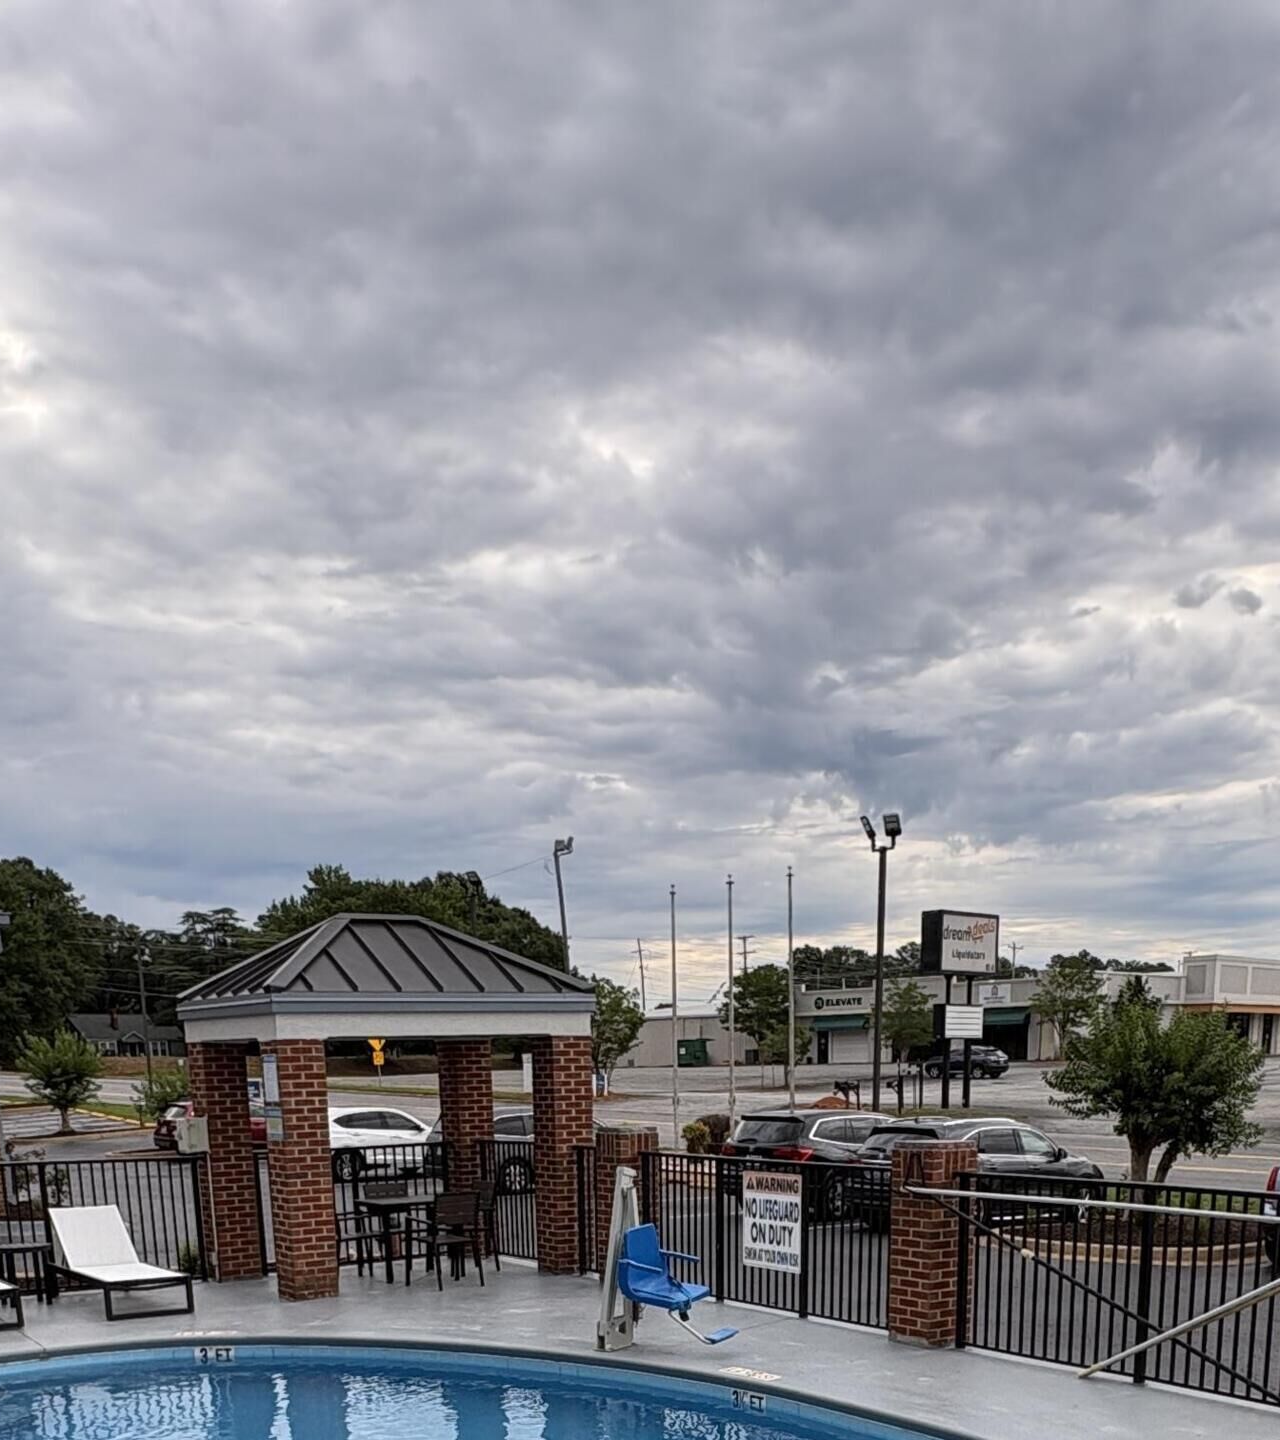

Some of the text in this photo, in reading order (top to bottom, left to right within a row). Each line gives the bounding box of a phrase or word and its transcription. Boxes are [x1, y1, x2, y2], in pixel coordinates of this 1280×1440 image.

[825, 997, 863, 1007] ELEVATE
[755, 1176, 799, 1194] WARNING
[745, 1198, 800, 1223] NO LIFEGUARD
[751, 1222, 794, 1248] ON DUTY
